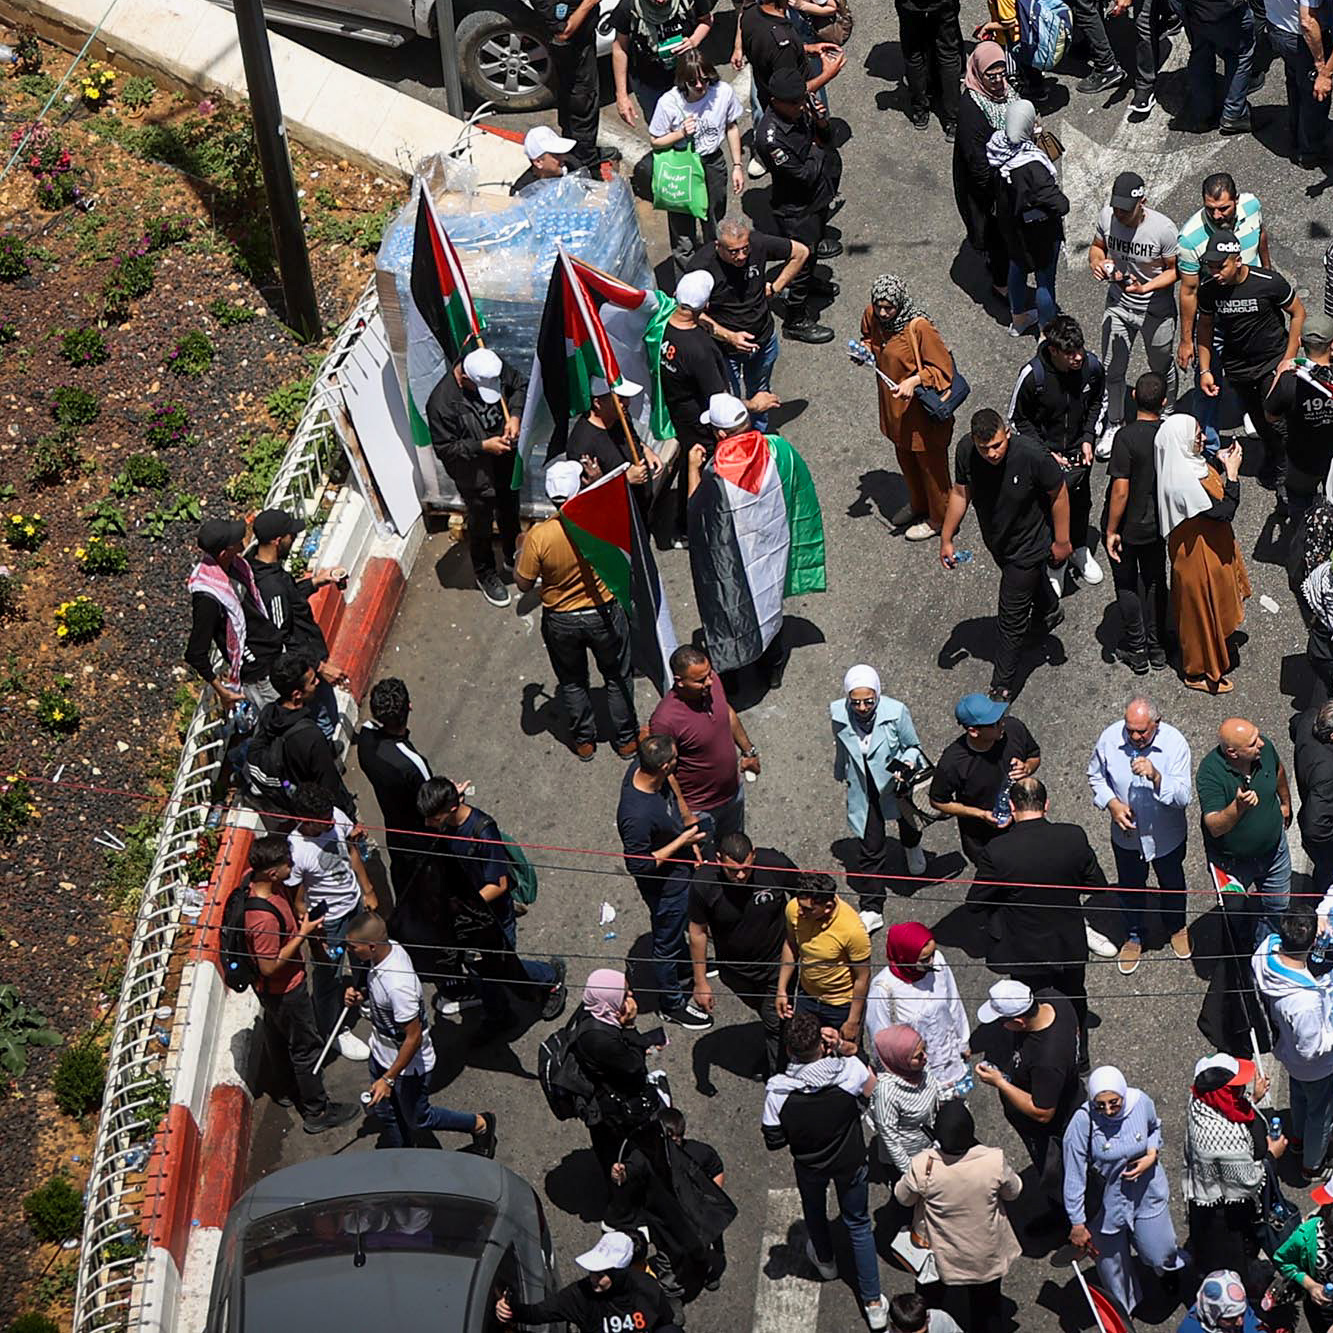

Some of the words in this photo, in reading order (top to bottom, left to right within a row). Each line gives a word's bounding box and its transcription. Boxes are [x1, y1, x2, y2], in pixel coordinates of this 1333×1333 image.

[1108, 235, 1154, 257] GIVENCHY
[1217, 241, 1241, 253] adid
[1215, 298, 1257, 308] UNDER
[1217, 305, 1259, 314] ARMOUR
[660, 340, 676, 360] 48
[603, 1311, 647, 1333] 1948
